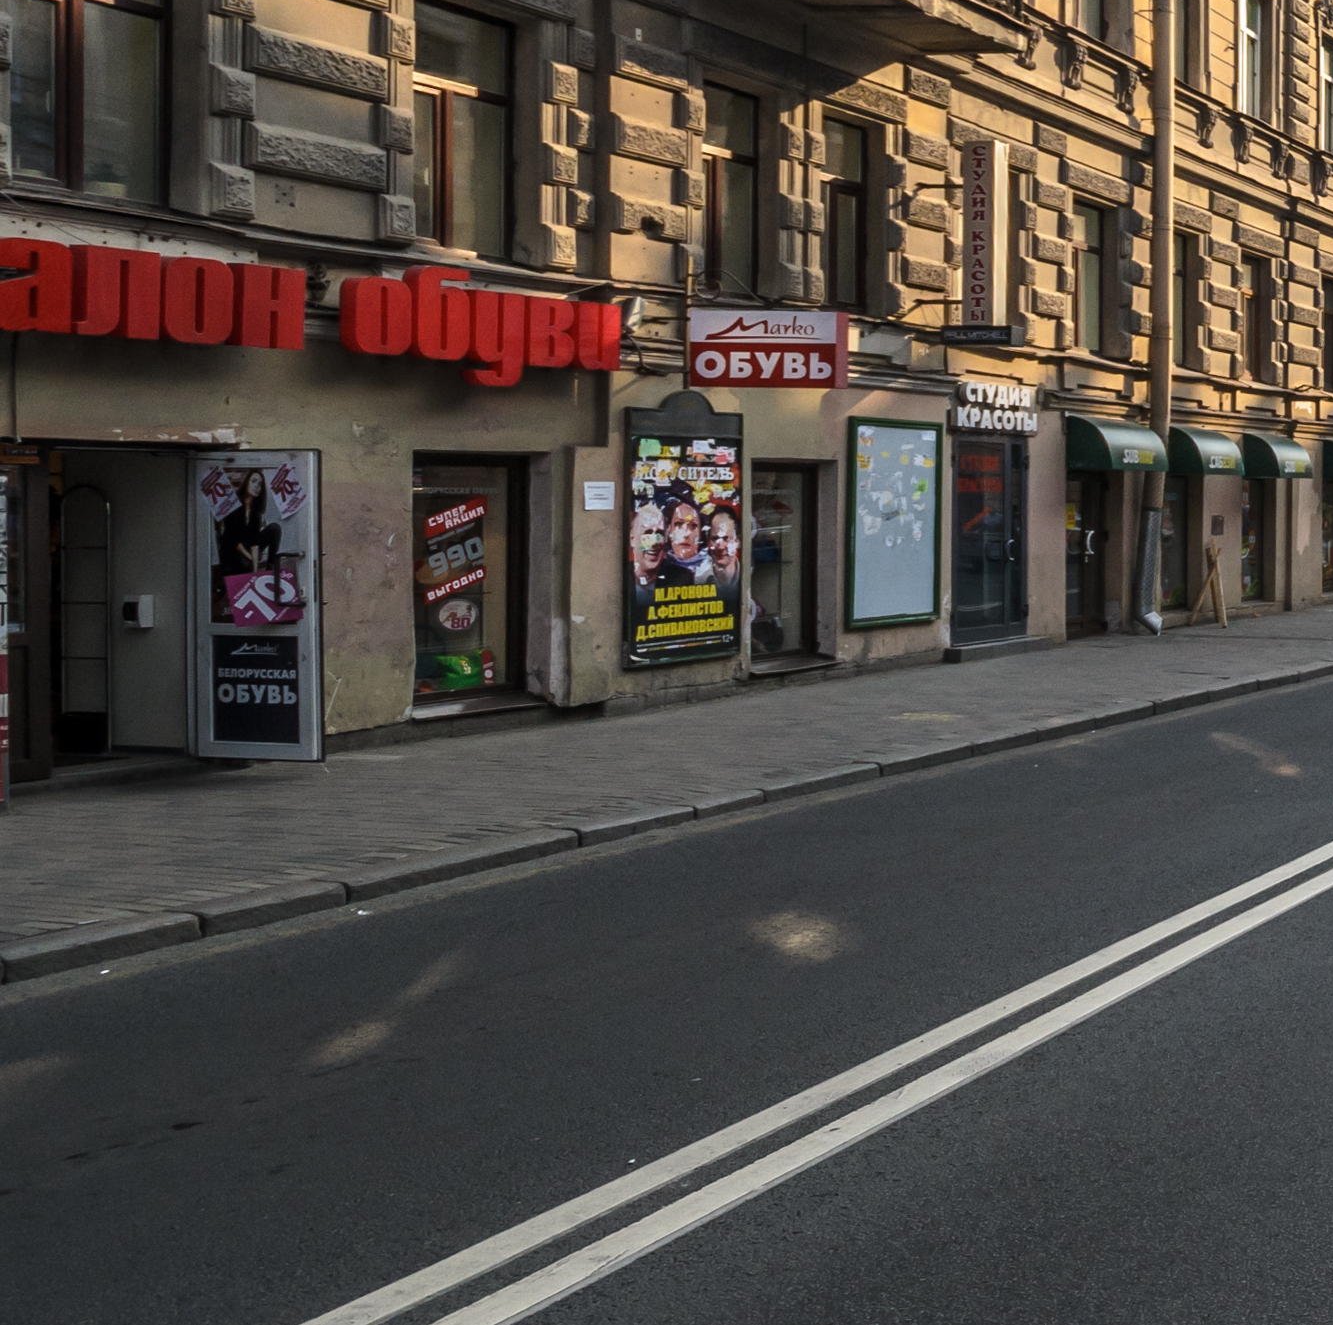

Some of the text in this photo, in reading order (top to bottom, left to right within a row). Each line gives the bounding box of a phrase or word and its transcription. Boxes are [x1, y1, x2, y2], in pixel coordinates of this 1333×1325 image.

[970, 145, 987, 322] СТУДИЯ КРАСОТЫ
[704, 315, 816, 341] Marko
[694, 350, 832, 380] ОБУВЬ
[965, 381, 1032, 408] СТУДИЯ
[957, 406, 1037, 432] КРАСОТЫ
[428, 504, 466, 527] СУПЕР
[445, 506, 485, 529] АКЦИЯ
[428, 536, 484, 577] 990
[427, 569, 484, 601] ВЫГОДНО
[218, 667, 297, 679] БЕЛОРУССКАЯ
[217, 682, 298, 705] ОБУВЬ
